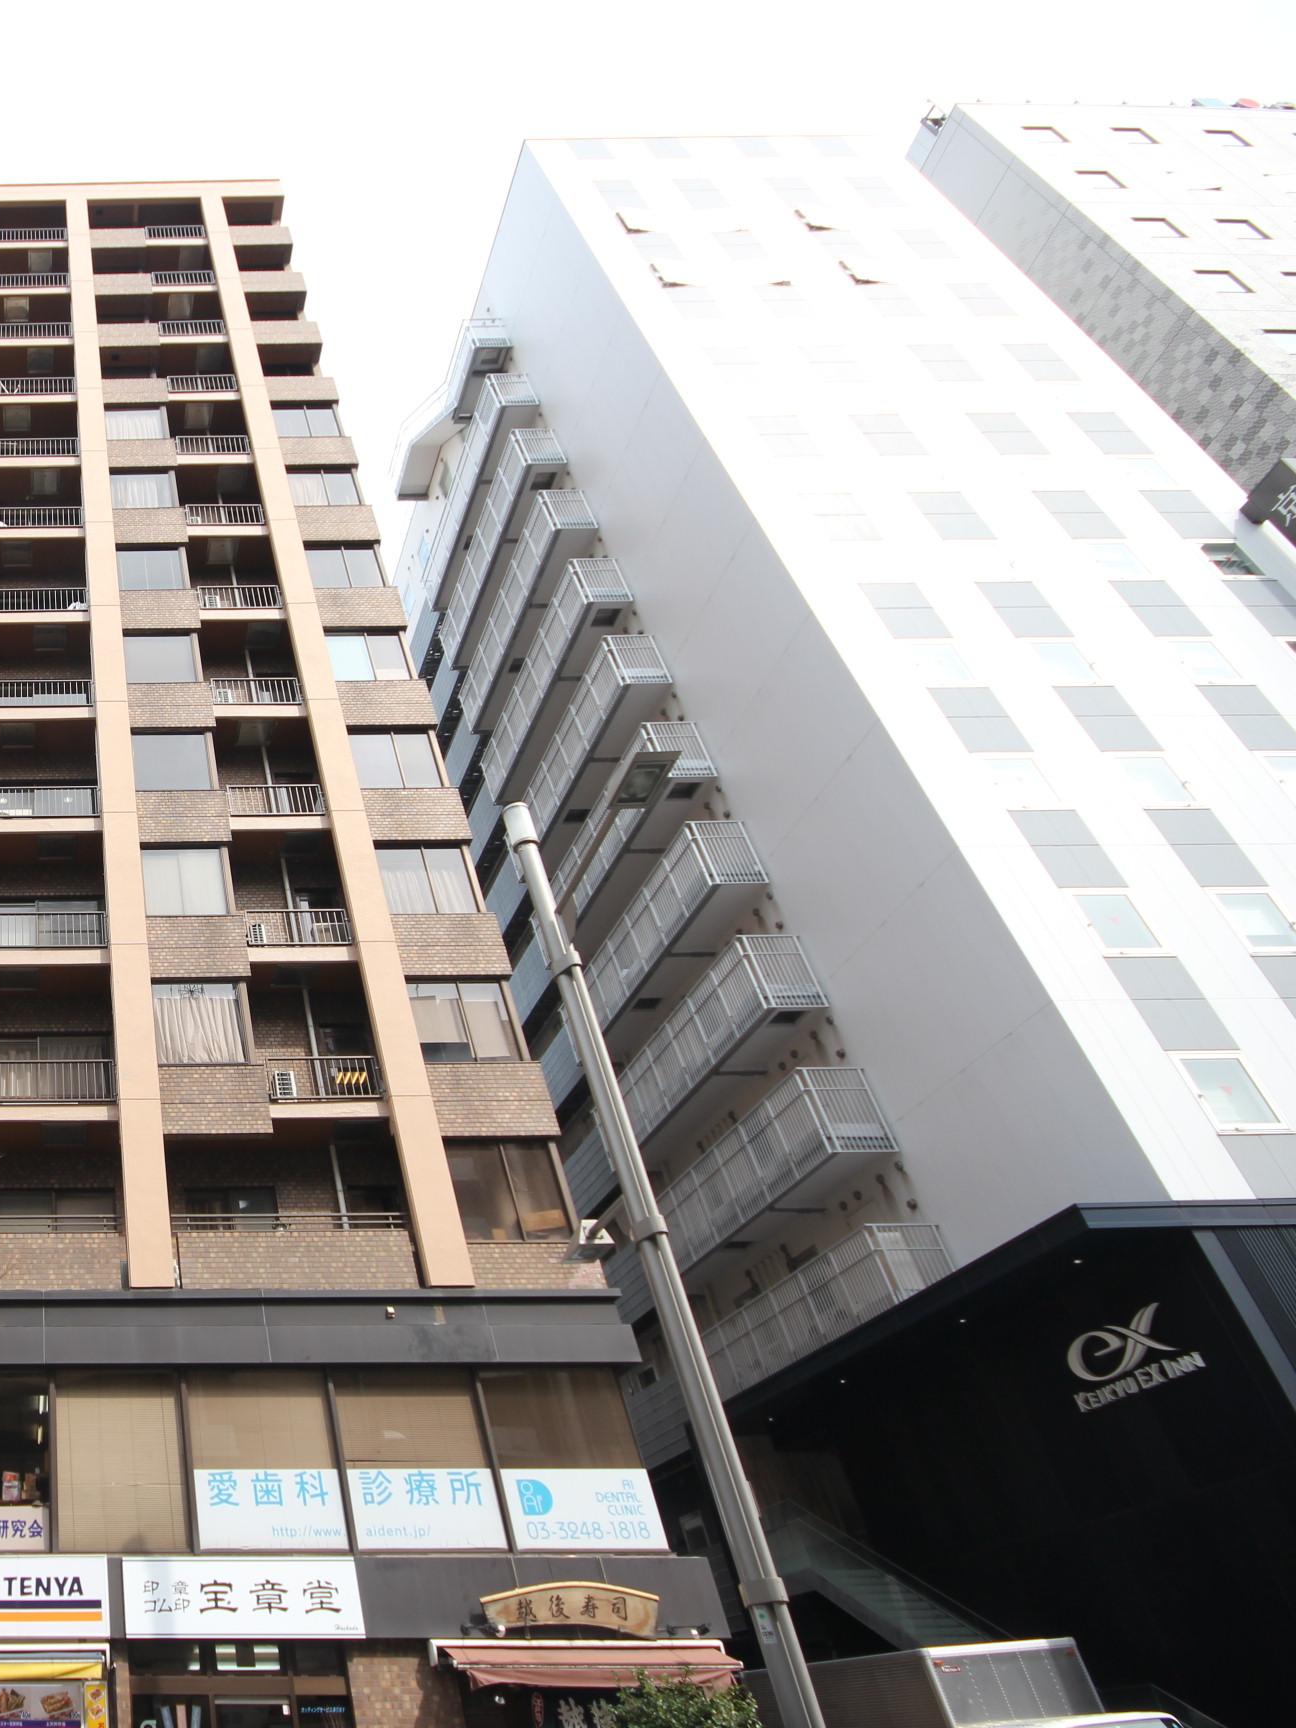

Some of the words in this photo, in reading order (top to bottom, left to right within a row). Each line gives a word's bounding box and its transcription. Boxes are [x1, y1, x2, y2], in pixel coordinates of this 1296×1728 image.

[1073, 1377, 1139, 1412] KEIKYU
[1134, 1363, 1168, 1389] EX
[207, 1470, 329, 1507] 愛歯科
[358, 1470, 483, 1506] 診療所
[595, 1492, 641, 1504] DENTAL
[607, 1505, 646, 1516] CLINIC
[526, 1521, 651, 1540] 03-3248-1818
[3, 1576, 84, 1598] TENYA
[200, 1579, 342, 1614] 宝章堂
[144, 1598, 190, 1613] ゴム印
[516, 1595, 627, 1622] 越後寿司
